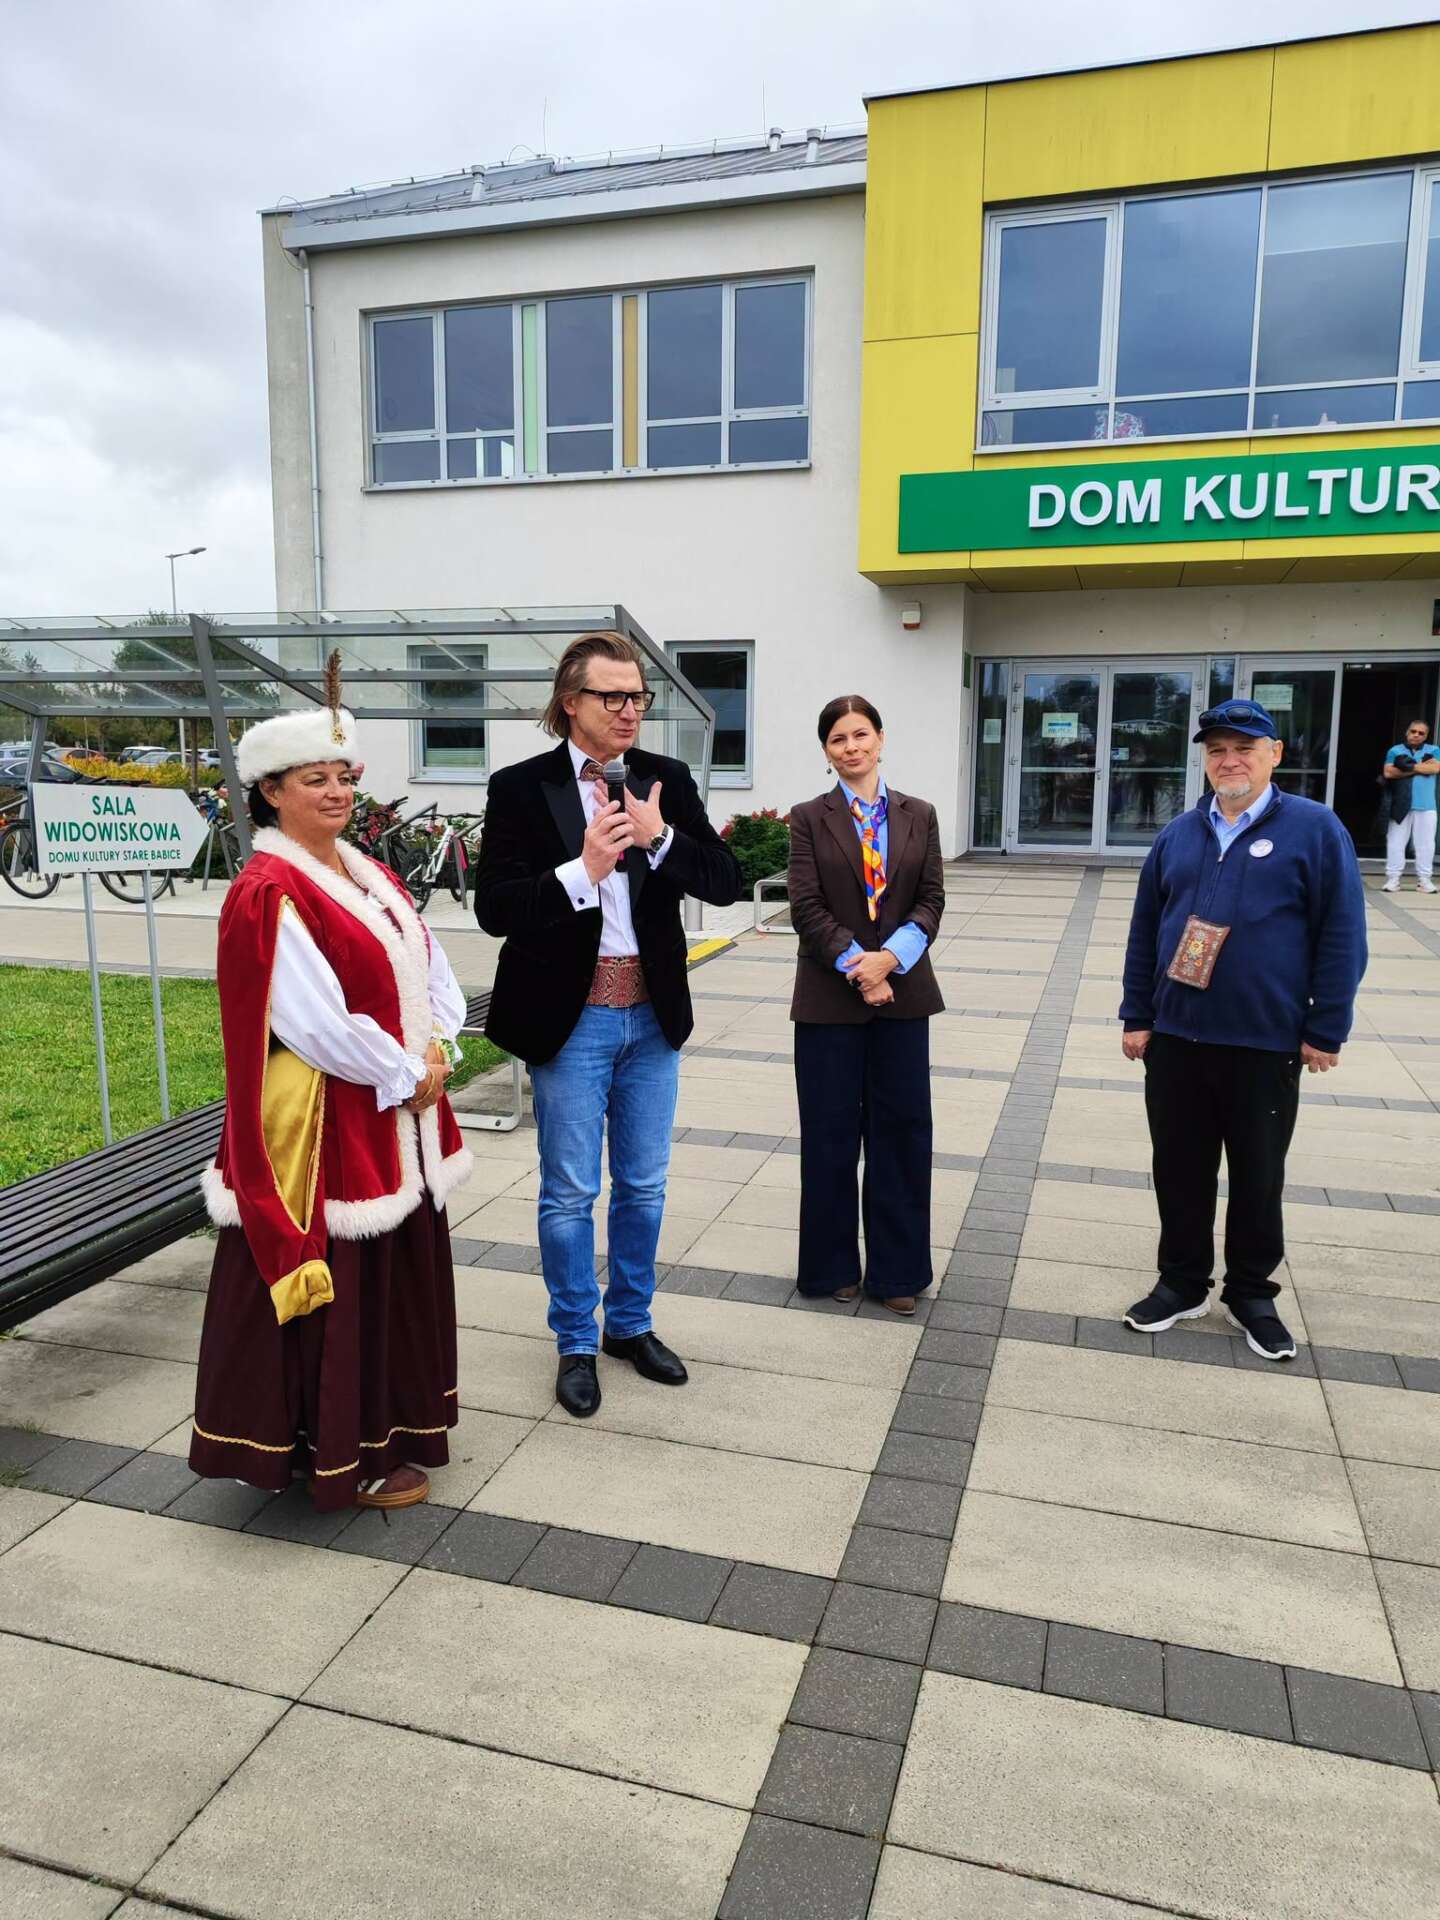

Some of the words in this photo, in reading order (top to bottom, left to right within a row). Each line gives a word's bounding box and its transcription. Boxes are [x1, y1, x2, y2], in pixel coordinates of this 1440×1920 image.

[1028, 477, 1162, 528] DOM
[1184, 464, 1440, 521] KULTUR
[91, 794, 137, 816] SALA
[44, 821, 182, 843] WIDOWISKOWA
[49, 851, 80, 864] DOMU
[82, 850, 120, 863] KULTURY
[123, 849, 149, 862] STARE
[150, 848, 181, 861] BABICE
